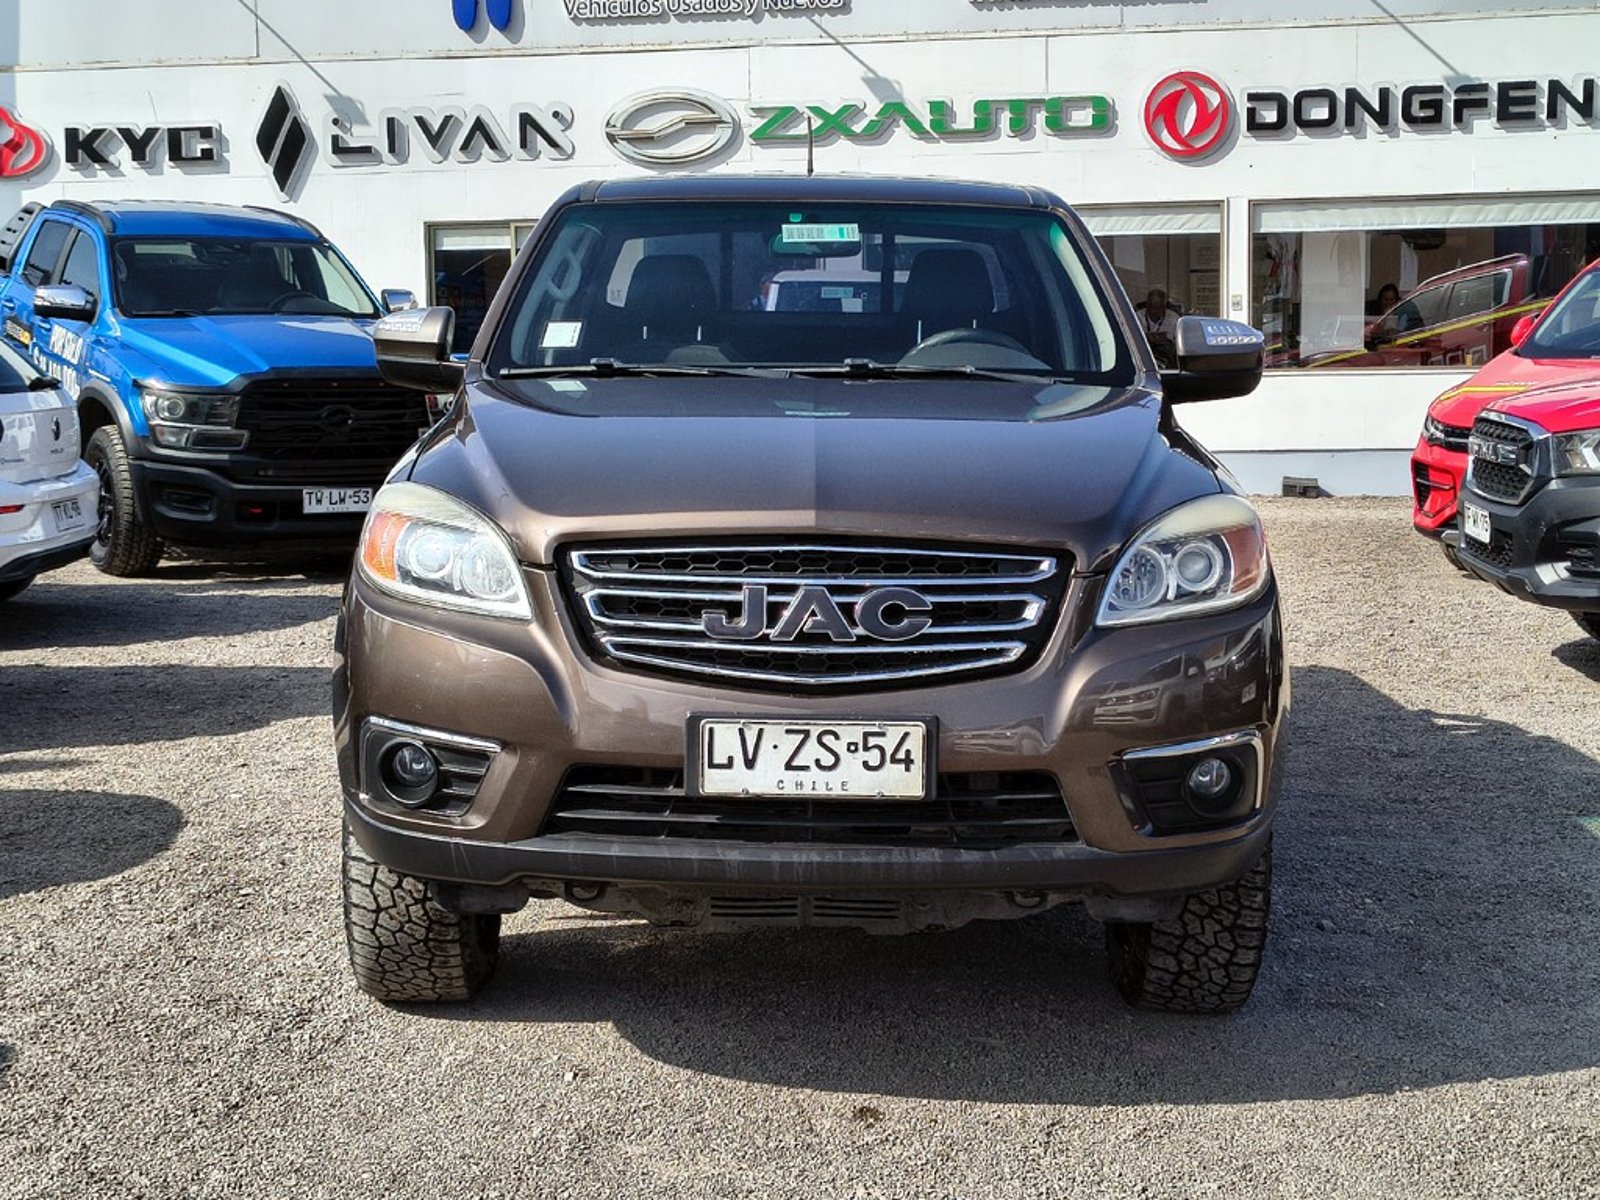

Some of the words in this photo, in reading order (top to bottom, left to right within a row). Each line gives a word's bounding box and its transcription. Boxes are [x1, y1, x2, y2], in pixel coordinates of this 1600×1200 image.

[750, 96, 1107, 142] ZXAUTO
[1247, 78, 1596, 131] DONGFEN
[65, 126, 215, 163] KYC
[331, 111, 564, 155] LIVAN
[701, 584, 932, 641] JAC
[776, 779, 850, 792] CHILE
